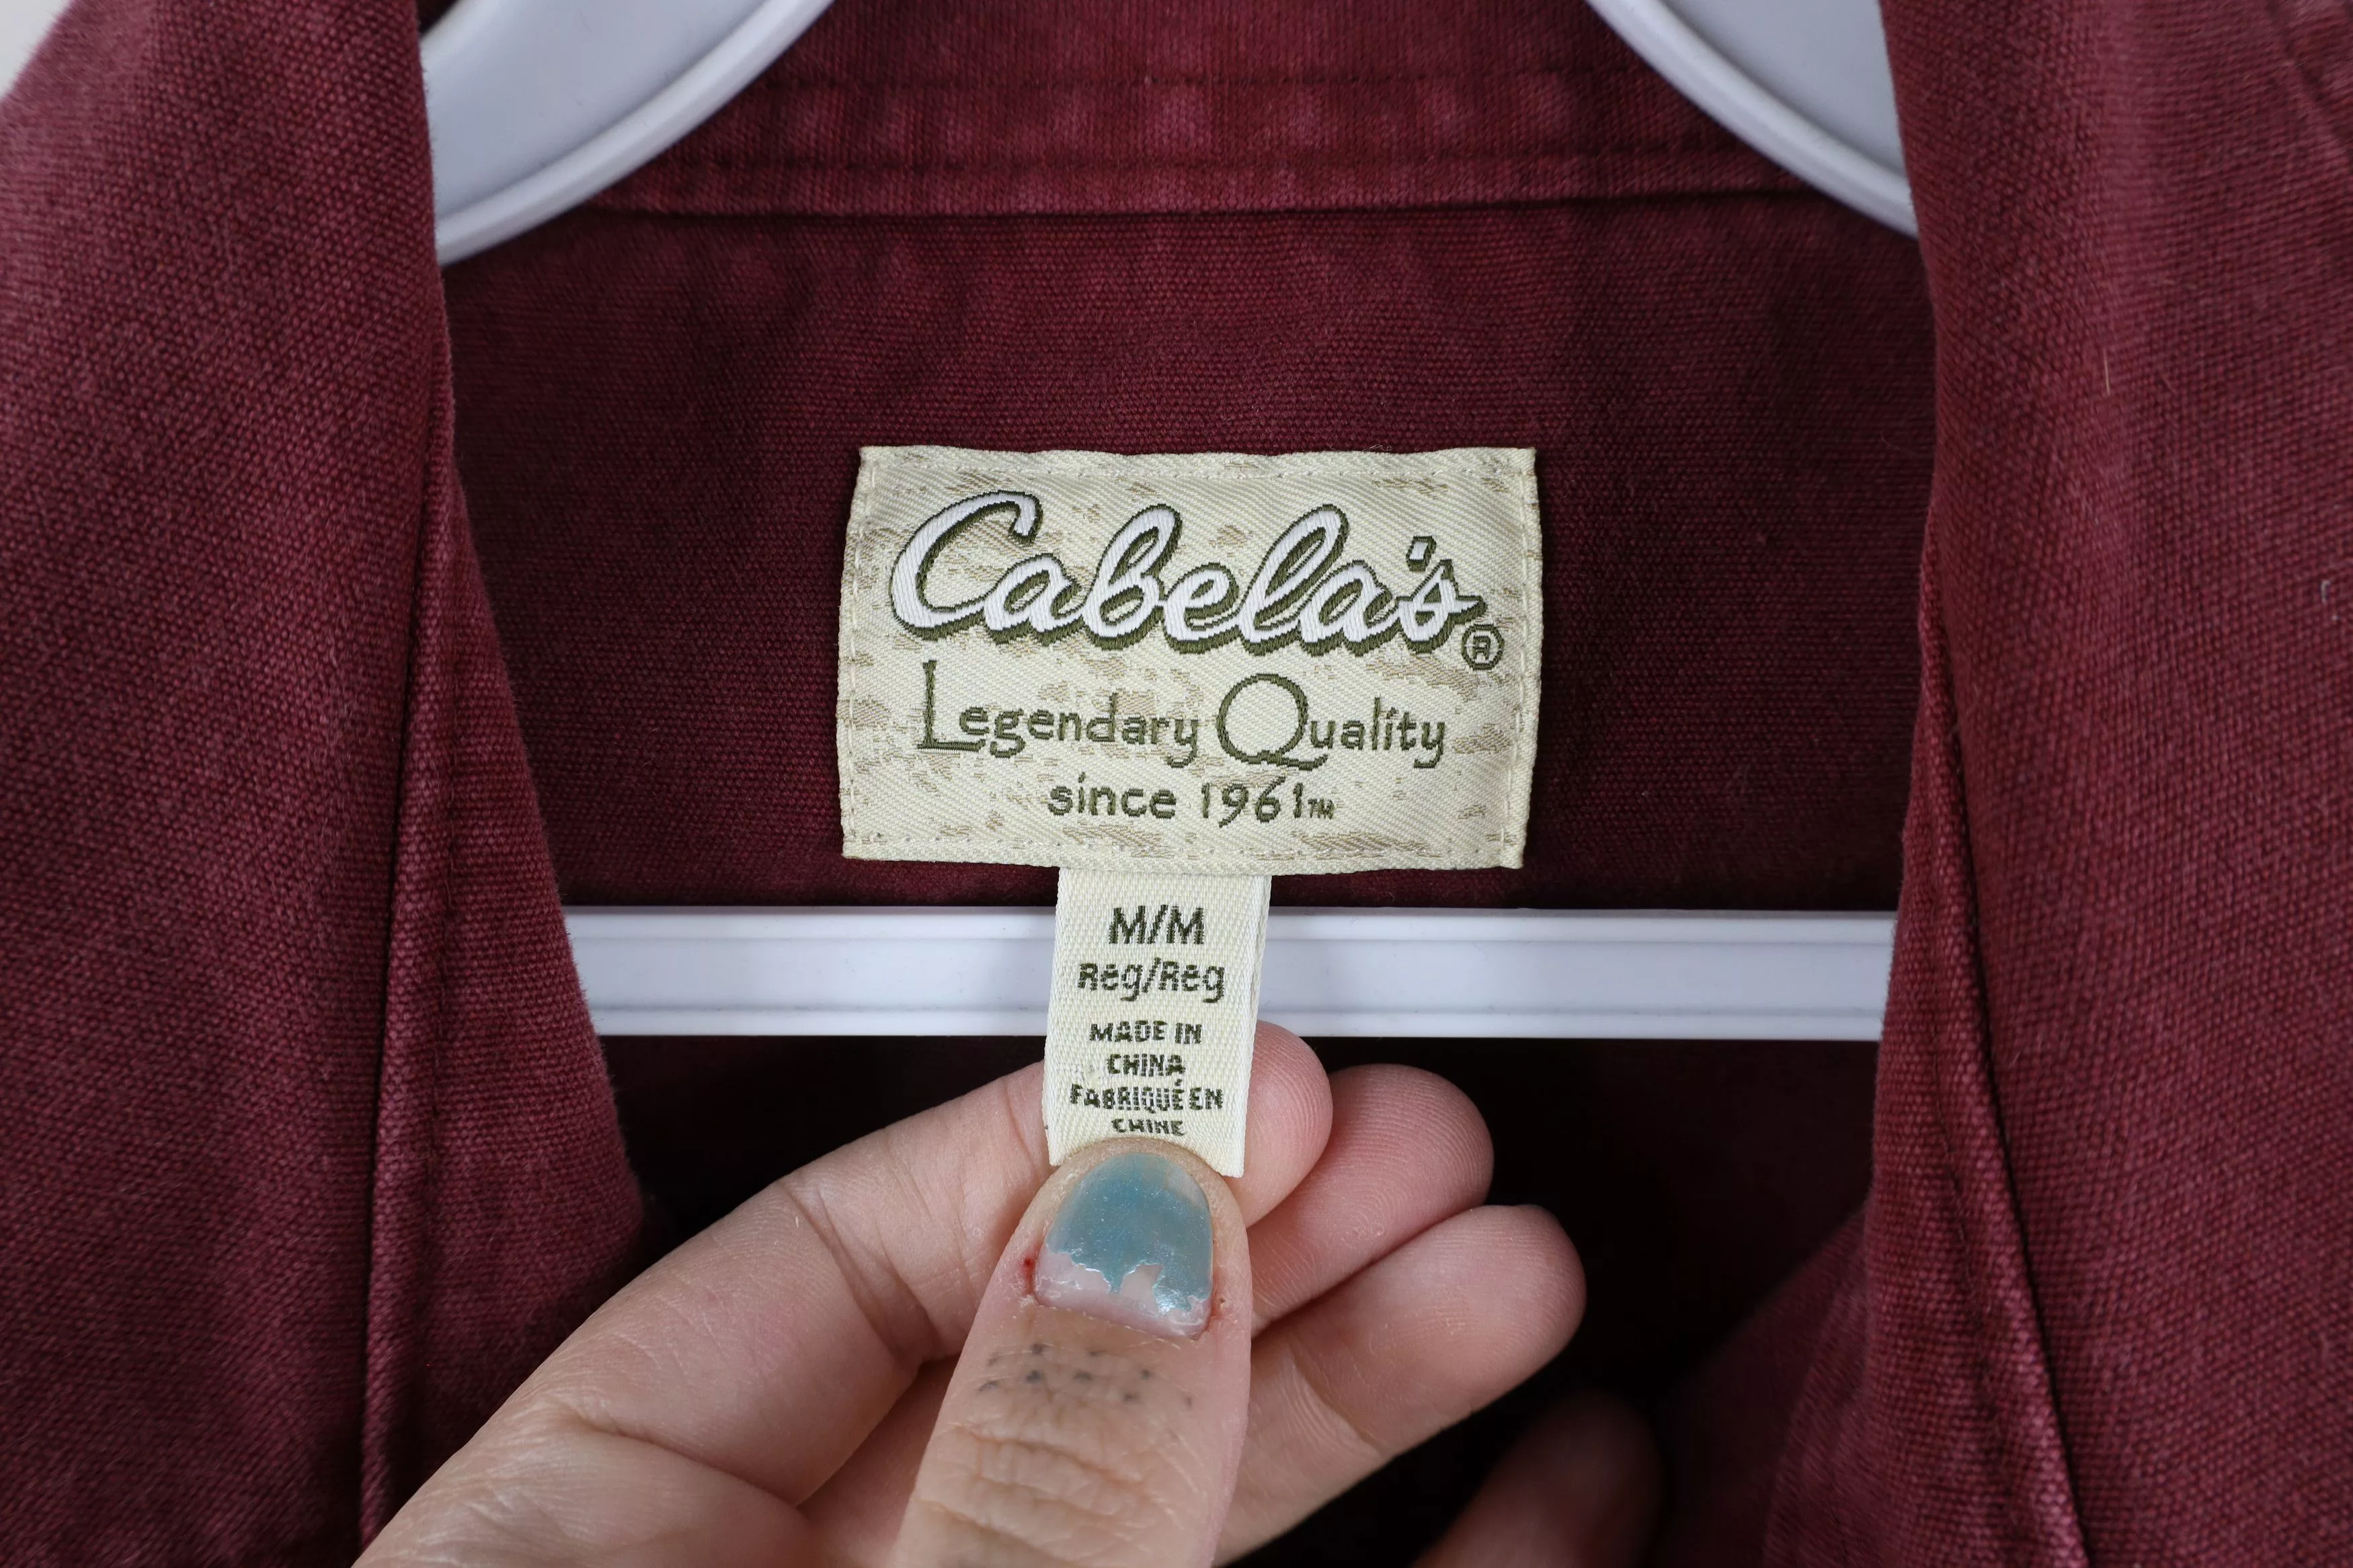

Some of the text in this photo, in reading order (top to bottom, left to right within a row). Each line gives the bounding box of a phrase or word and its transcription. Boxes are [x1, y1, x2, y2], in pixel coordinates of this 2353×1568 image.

[918, 659, 1447, 771] Legendary Quality
[1047, 772, 1176, 820] since
[1109, 904, 1205, 945] M/M
[1077, 957, 1225, 1003] Reg/Reg
[1089, 1020, 1203, 1044] MADE IN
[1106, 1053, 1186, 1077] CHINA
[1070, 1078, 1224, 1114] FABRIQUÉ EN
[1111, 1118, 1186, 1137] CHINE
